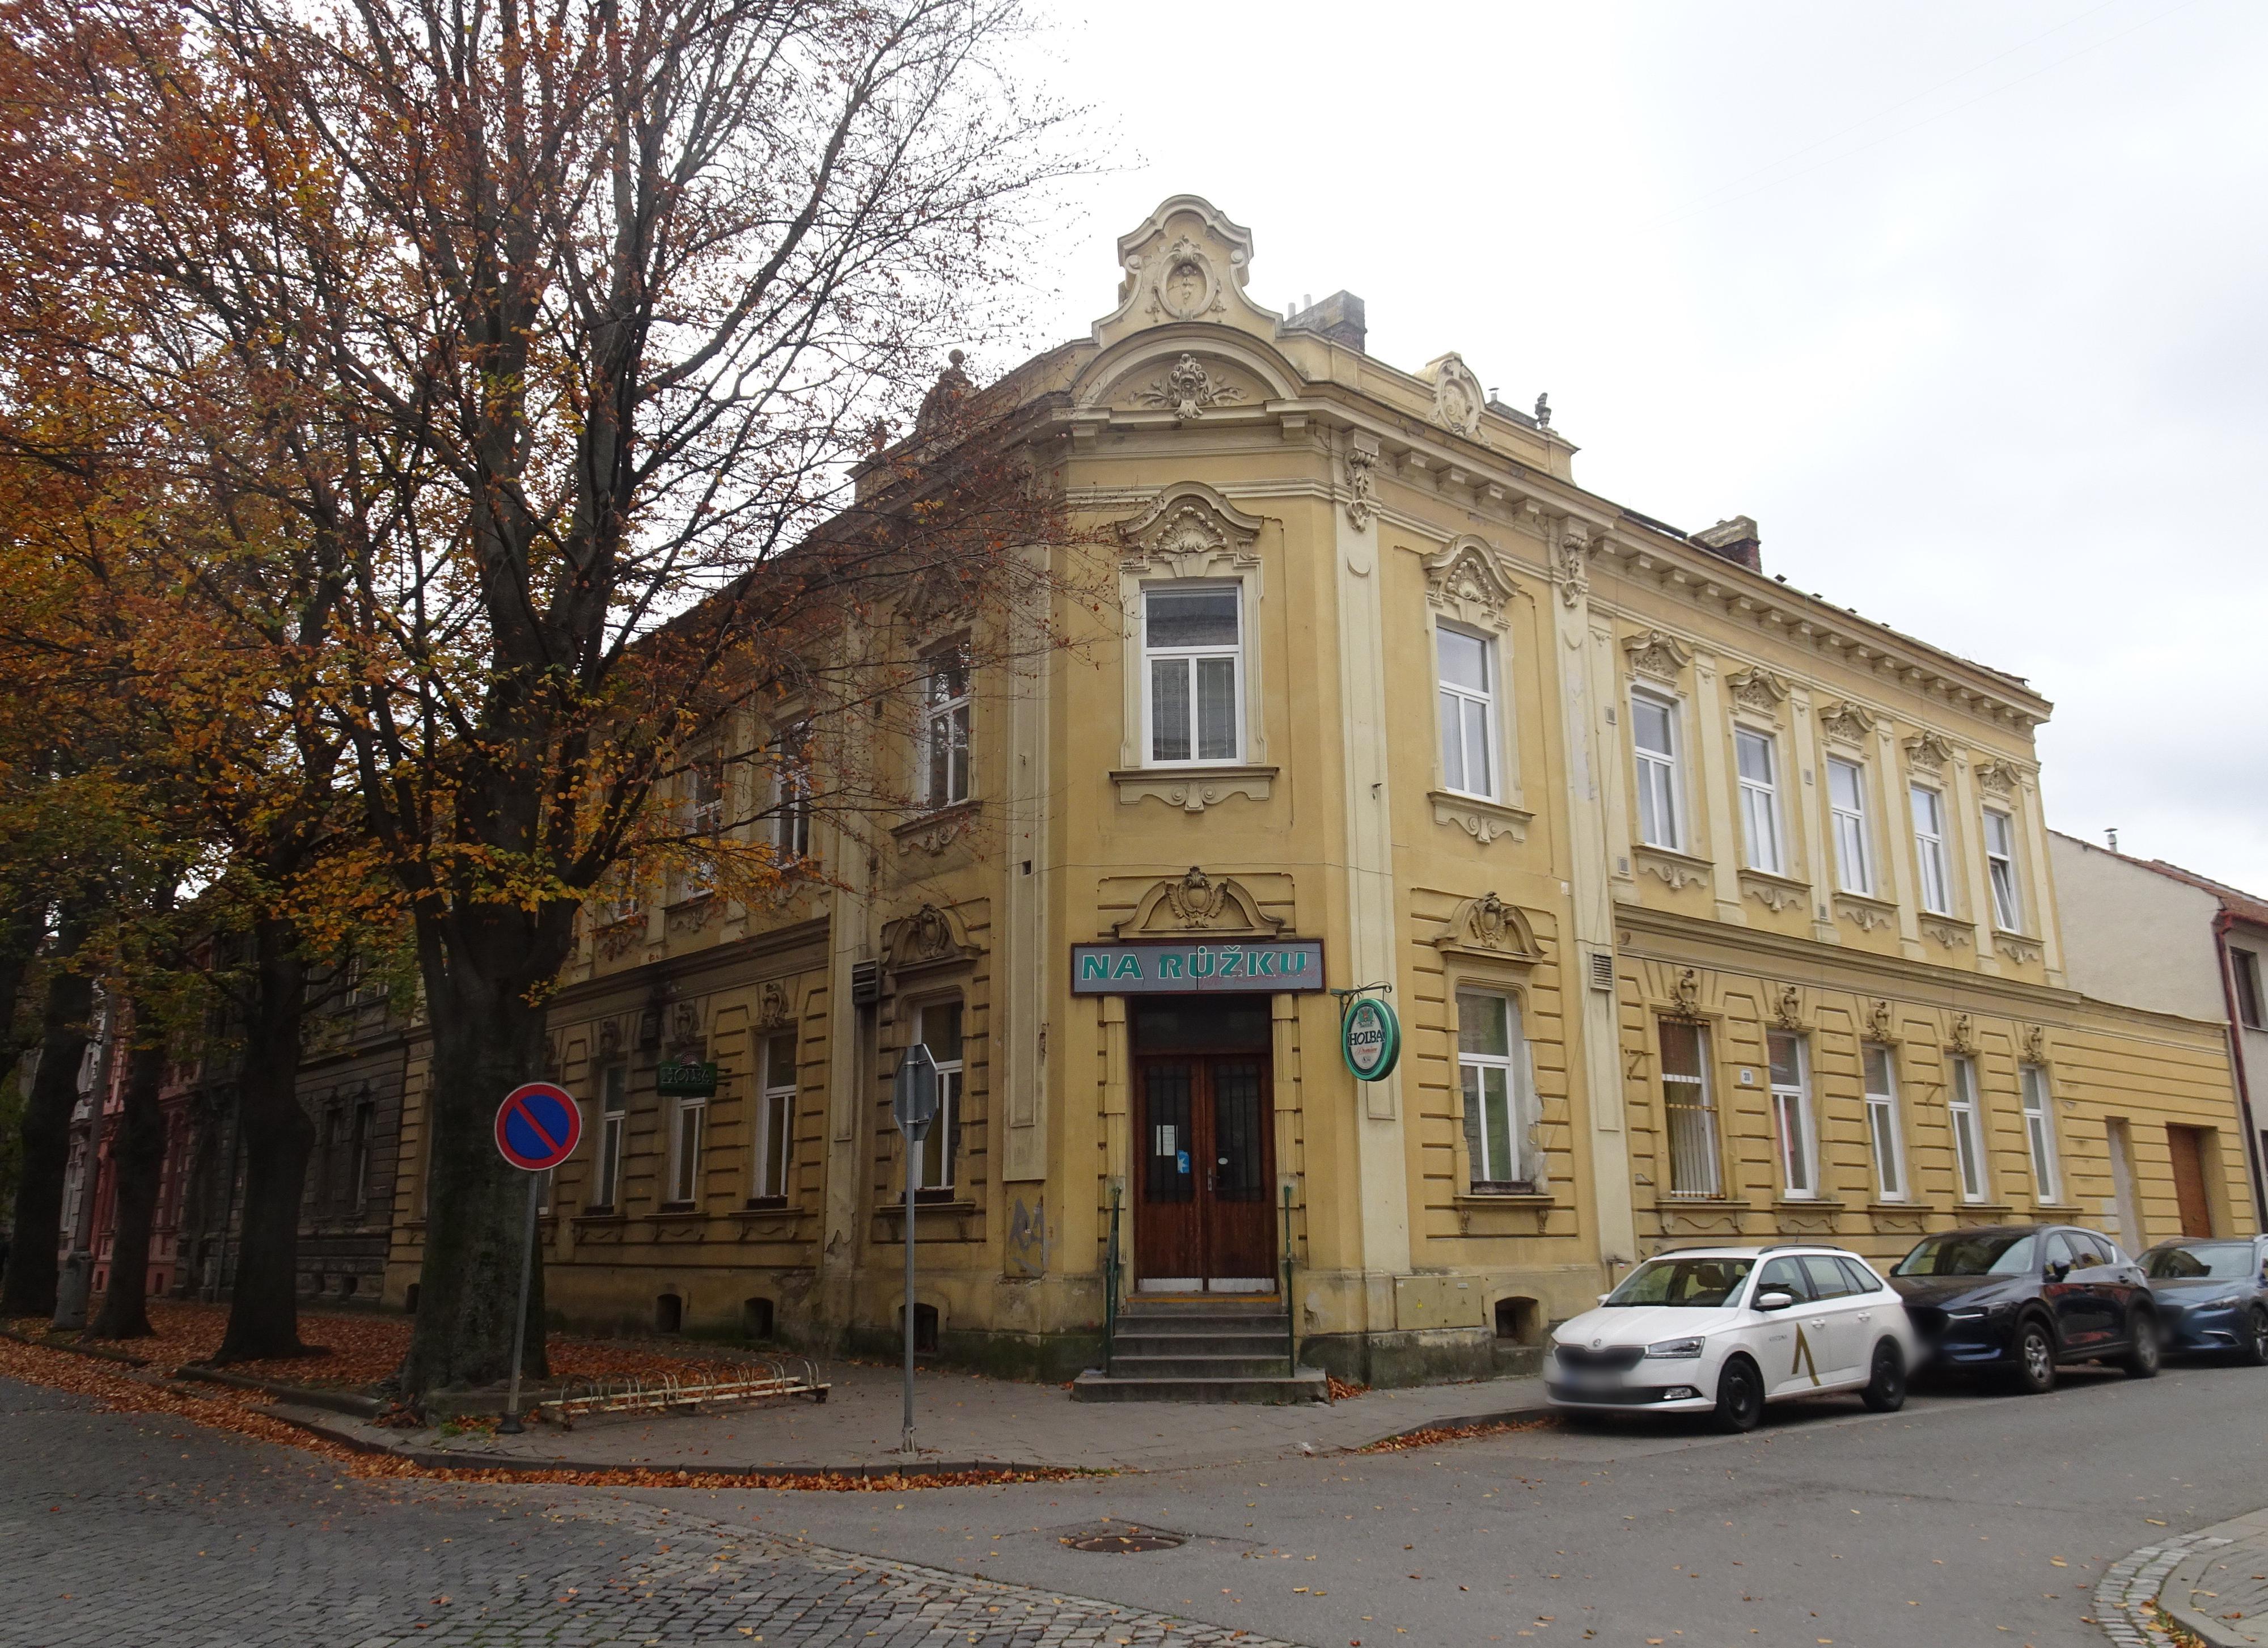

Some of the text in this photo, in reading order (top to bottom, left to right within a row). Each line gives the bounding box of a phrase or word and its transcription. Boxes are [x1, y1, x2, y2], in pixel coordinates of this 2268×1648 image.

[1081, 954, 1144, 981] NA
[1158, 945, 1307, 979] RŮŽKU
[1348, 1030, 1385, 1045] HOLBA
[661, 1067, 713, 1084] HOLBA
